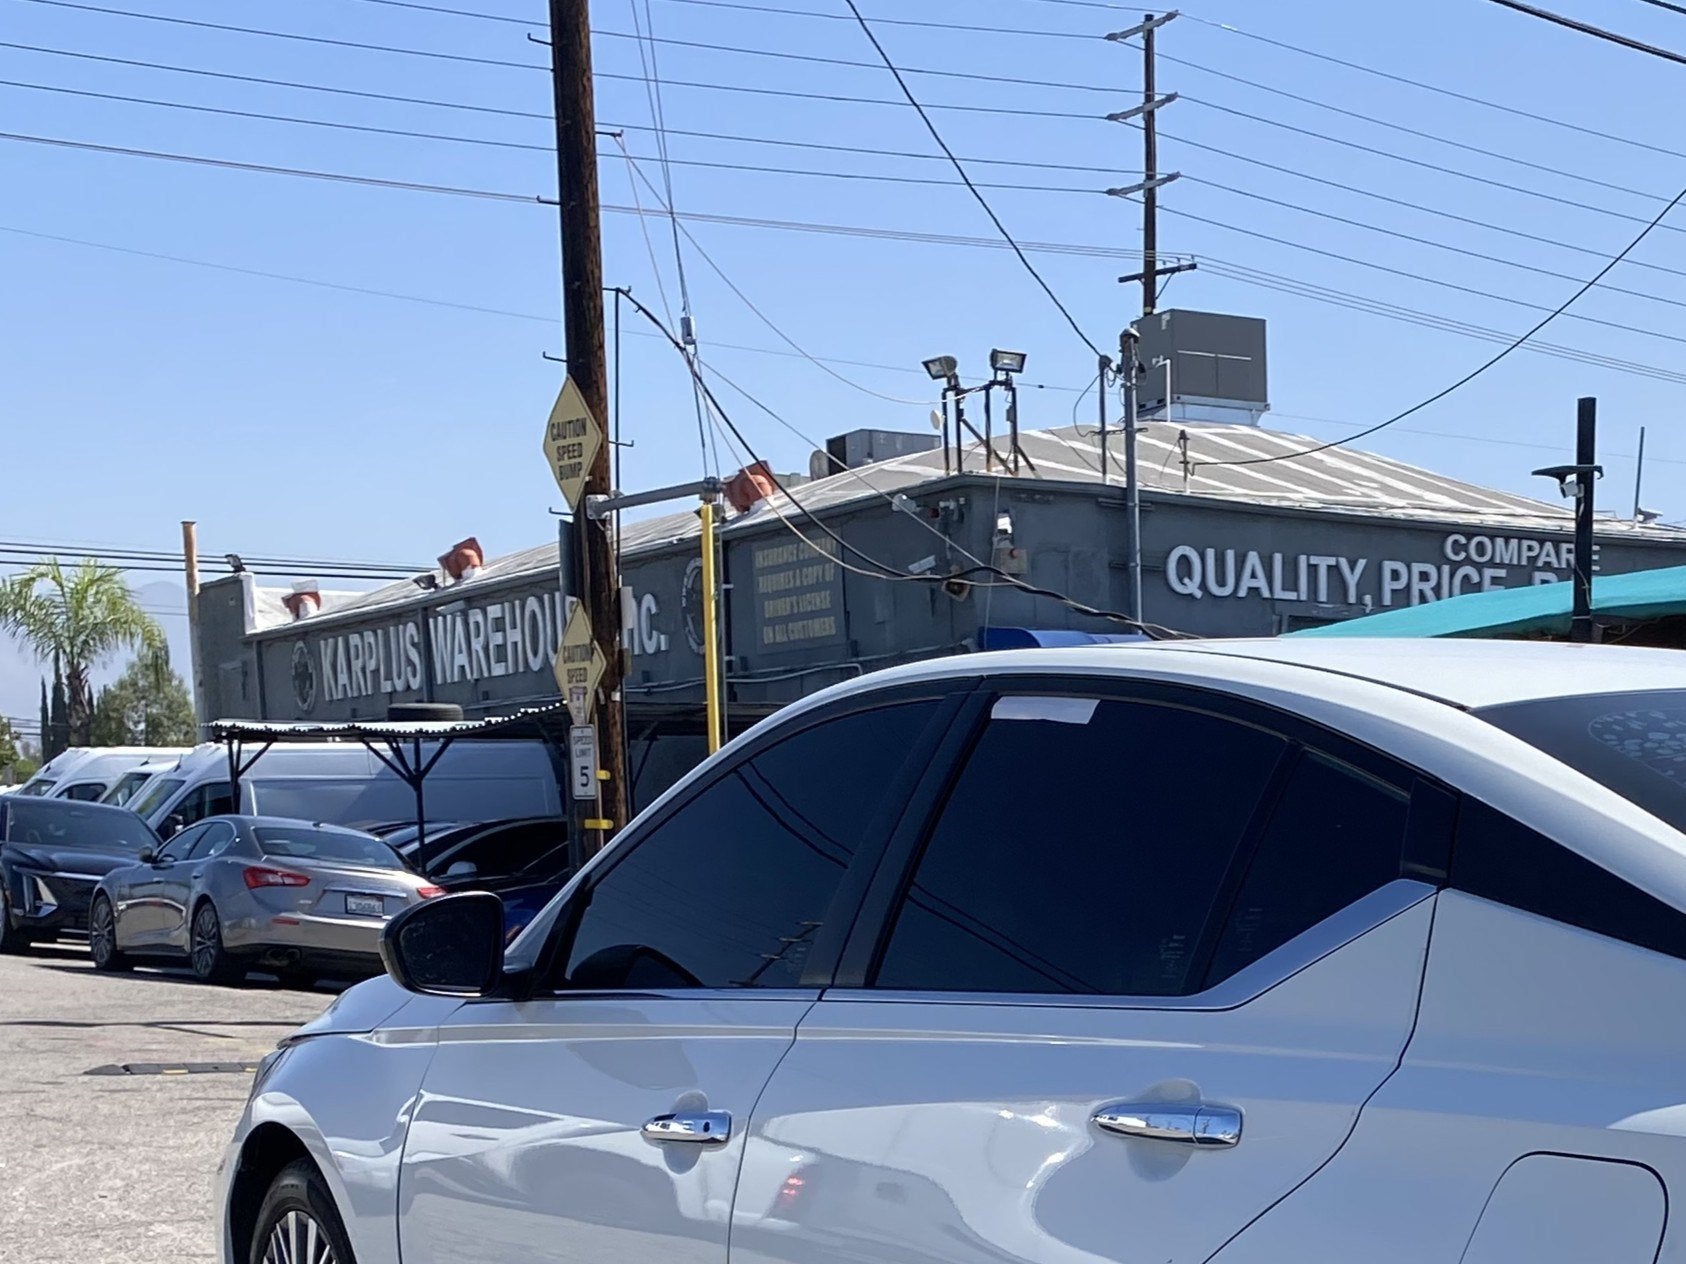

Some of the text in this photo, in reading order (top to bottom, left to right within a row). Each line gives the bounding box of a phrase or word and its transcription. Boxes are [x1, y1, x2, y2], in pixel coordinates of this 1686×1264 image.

[551, 417, 587, 442] CAUTION
[557, 442, 583, 462] SPEED
[559, 461, 582, 481] BUMP
[1166, 545, 1375, 614] QUALITY,
[320, 621, 423, 701] KARPLUS
[566, 667, 588, 684] SPEED
[573, 736, 593, 746] SPEED
[575, 748, 592, 759] LIMIT
[580, 765, 590, 788] 5
